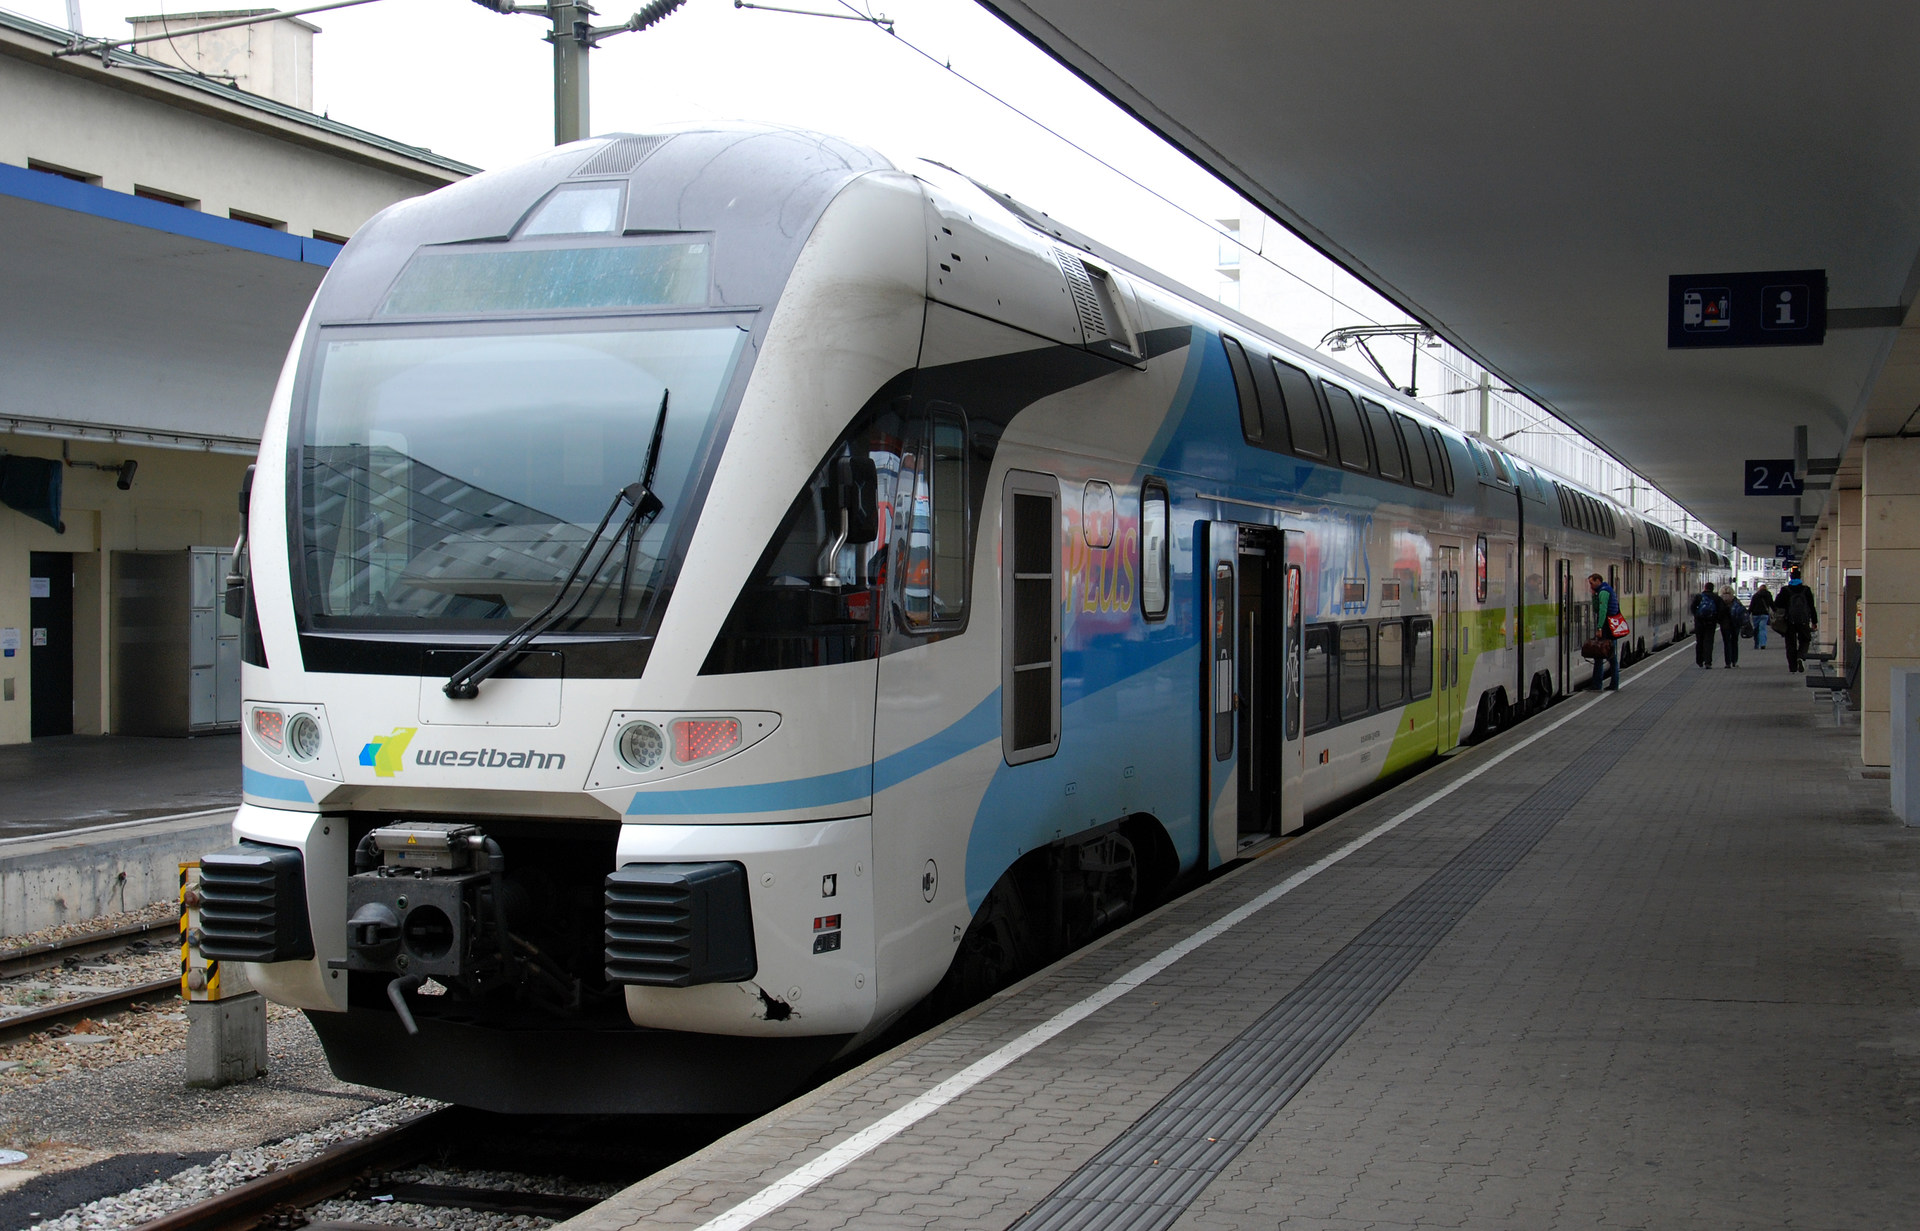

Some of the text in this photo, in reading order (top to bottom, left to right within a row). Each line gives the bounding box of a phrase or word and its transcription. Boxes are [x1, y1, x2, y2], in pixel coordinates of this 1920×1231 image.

[1752, 466, 1796, 490] 2 A
[1316, 505, 1373, 617] PLUS
[1777, 547, 1785, 557] 2
[1065, 526, 1137, 614] PLUS
[416, 748, 566, 770] westbahn
